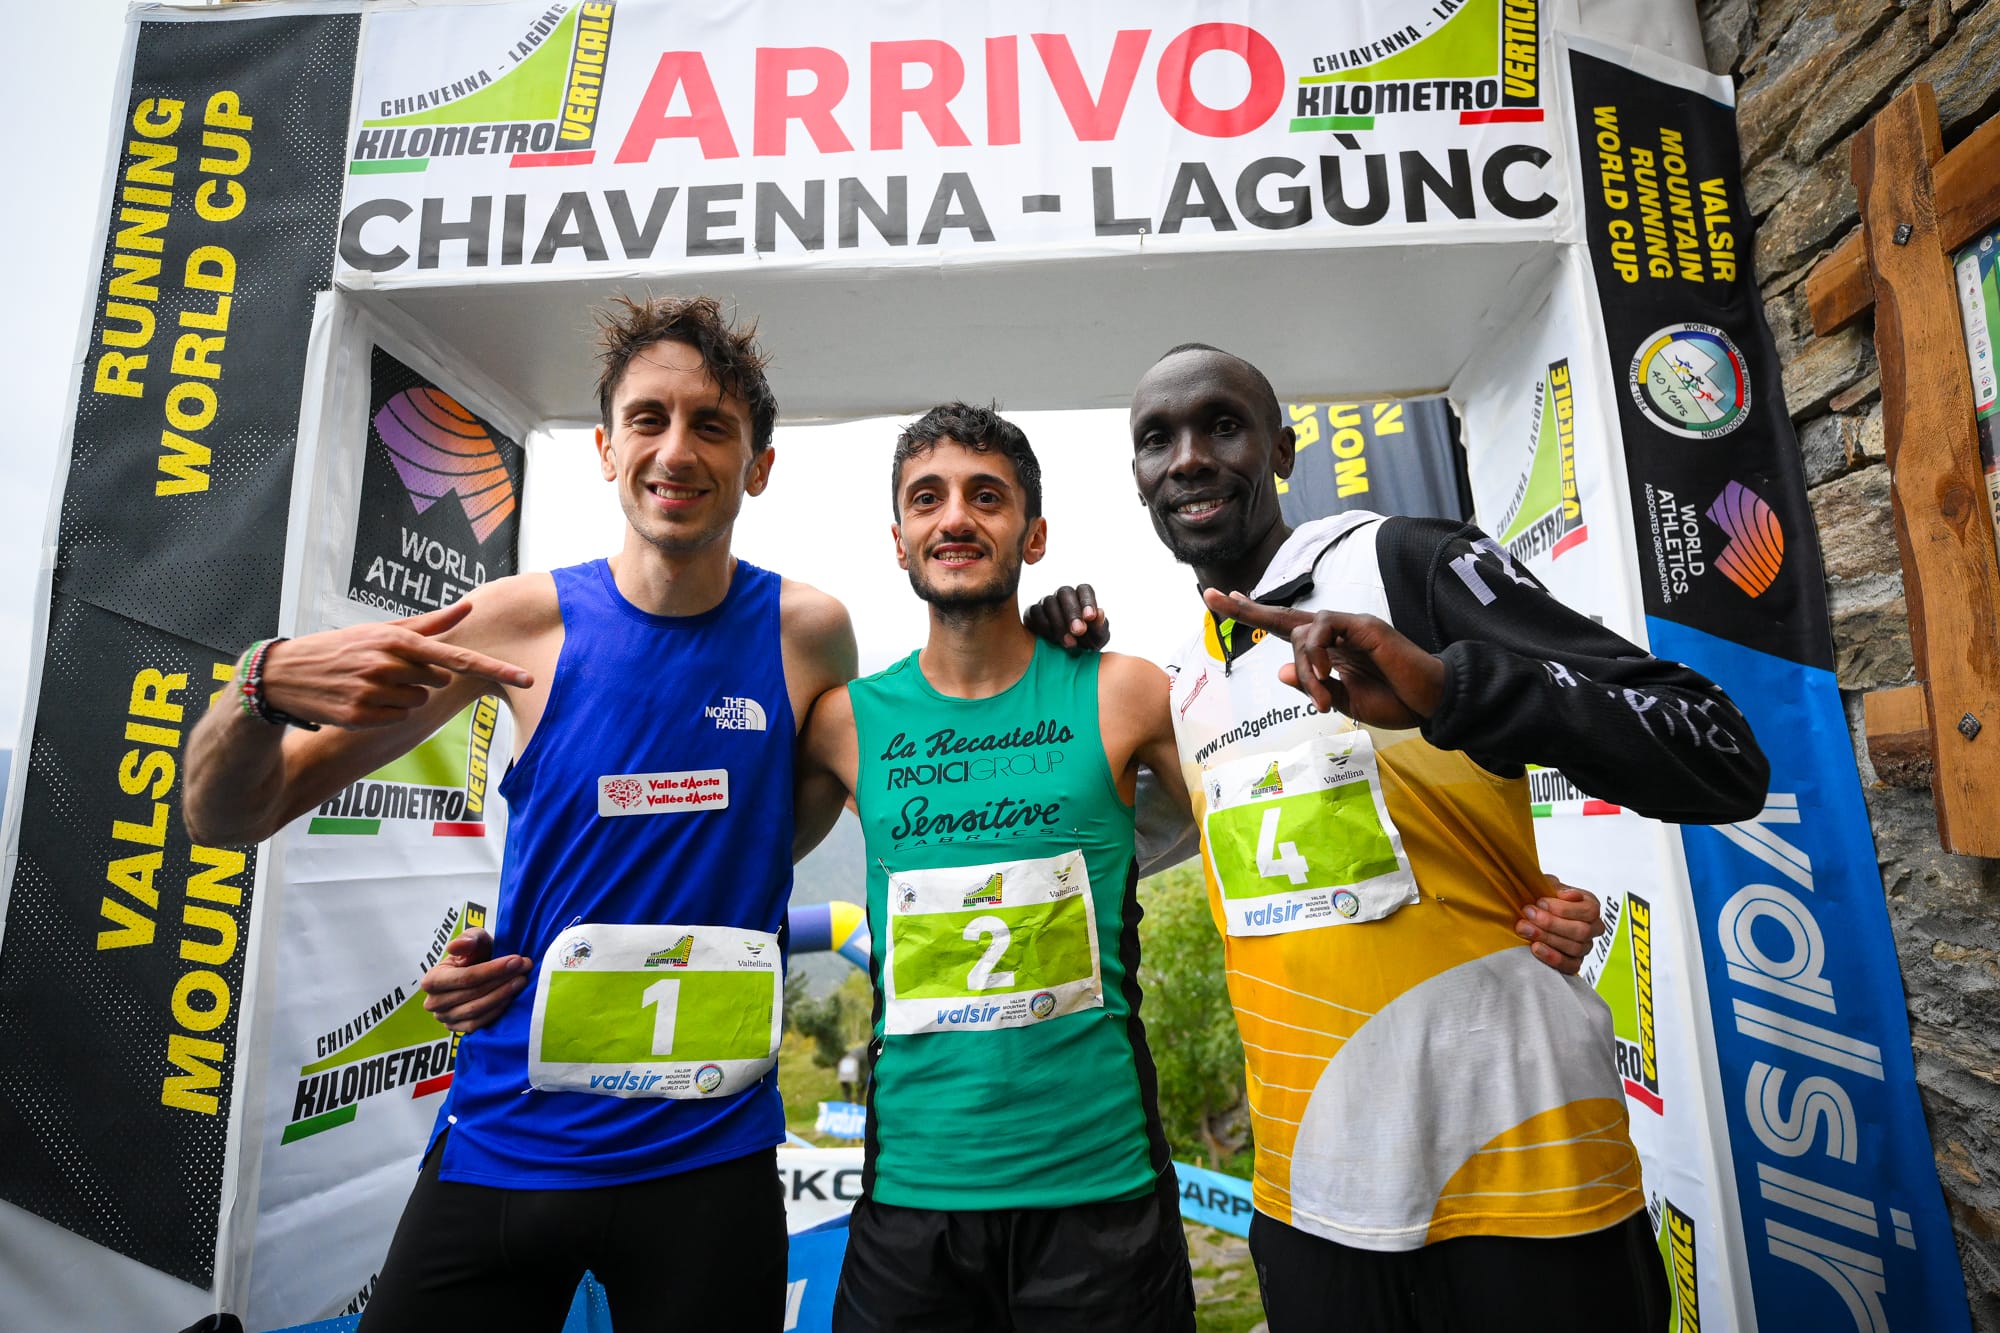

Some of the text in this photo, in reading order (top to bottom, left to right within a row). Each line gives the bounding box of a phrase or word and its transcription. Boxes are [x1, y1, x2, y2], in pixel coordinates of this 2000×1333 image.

[560, 1, 613, 141] VERTICALE
[1313, 25, 1422, 73] CHIAVENNA
[381, 70, 492, 117] CHIAVENNA
[613, 22, 1285, 164] ARRIVO
[1297, 80, 1498, 117] KILOMETRO
[354, 123, 555, 160] KILOMETRO
[338, 133, 1558, 271] CHIAVENNA - LAGÙNC
[1593, 106, 1639, 284] WORLD CUP
[1630, 146, 1674, 279] RUNNING
[1659, 127, 1704, 283] MOUNTAIN
[1700, 177, 1736, 282] VALSIR
[93, 98, 186, 398] RUNNING
[154, 90, 254, 497] WORLD CUP
[1630, 358, 1648, 412] SINCE 1984
[1652, 370, 1688, 417] 40 Years
[1684, 324, 1717, 334] WORLD
[1701, 409, 1749, 438] ASSOCIATION
[402, 527, 486, 588] WORLD
[1644, 483, 1672, 604] ASSOCIATED ORGANISATIONS
[1657, 489, 1689, 595] ATHLETICS
[1681, 503, 1705, 577] WORLD
[365, 555, 466, 613] ATHLE
[705, 706, 746, 718] NORTH
[716, 718, 746, 730] FACE
[723, 697, 746, 708] THE
[466, 695, 498, 813] VERTICAL
[880, 719, 1074, 761] La Recastello
[1324, 768, 1365, 785] Valtellina
[97, 667, 188, 950] VALSIR
[648, 779, 679, 792] Valle
[891, 795, 1060, 840] Sensitive
[893, 828, 1055, 850] FABRICS
[1255, 807, 1310, 885] 4
[1049, 884, 1080, 899] Valtellina
[1245, 899, 1304, 926] valsir
[737, 960, 773, 968] Valtellina
[962, 915, 1015, 991] 2
[316, 985, 406, 1058] CHIAVENNA
[641, 978, 681, 1056] 1
[937, 1003, 1000, 1025] valsir
[1630, 900, 1656, 1081] VERTICALE
[291, 1041, 449, 1122] KILOMETRO
[589, 1070, 663, 1092] valsir
[1713, 793, 1917, 1333] valsir
